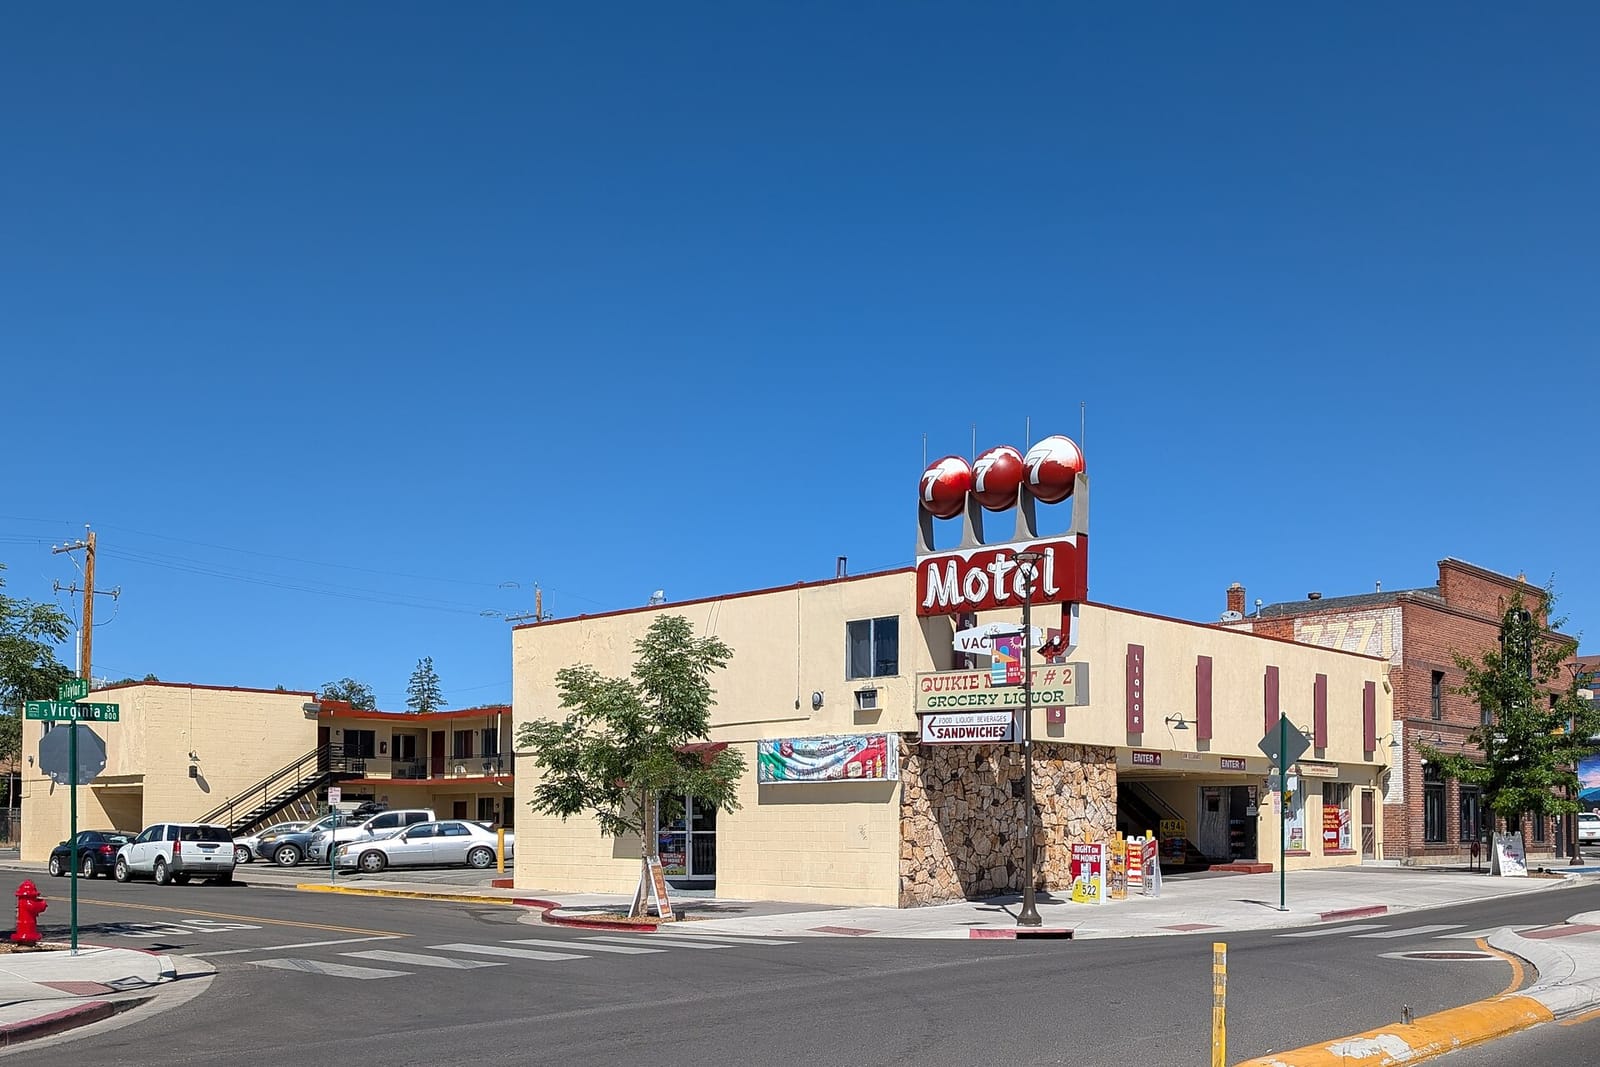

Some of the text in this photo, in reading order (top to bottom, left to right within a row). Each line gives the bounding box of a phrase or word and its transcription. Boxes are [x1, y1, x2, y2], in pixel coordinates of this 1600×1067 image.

[922, 449, 1053, 502] 7 7 7
[922, 547, 1060, 608] Motel
[920, 674, 979, 693] QUIKIE
[1043, 670, 1056, 685] #
[1063, 668, 1072, 685] 2
[65, 683, 81, 699] Taylor
[927, 693, 999, 707] GROCERY
[43, 708, 48, 716] S
[50, 703, 100, 720] Virginia
[106, 705, 114, 713] St
[936, 726, 1006, 739] SANDWICHES
[1133, 754, 1154, 763] ENTER
[1221, 759, 1240, 768] ENTER
[1074, 845, 1092, 853] RIGHT
[1080, 854, 1101, 863] MONEY
[1082, 884, 1097, 896] 522
